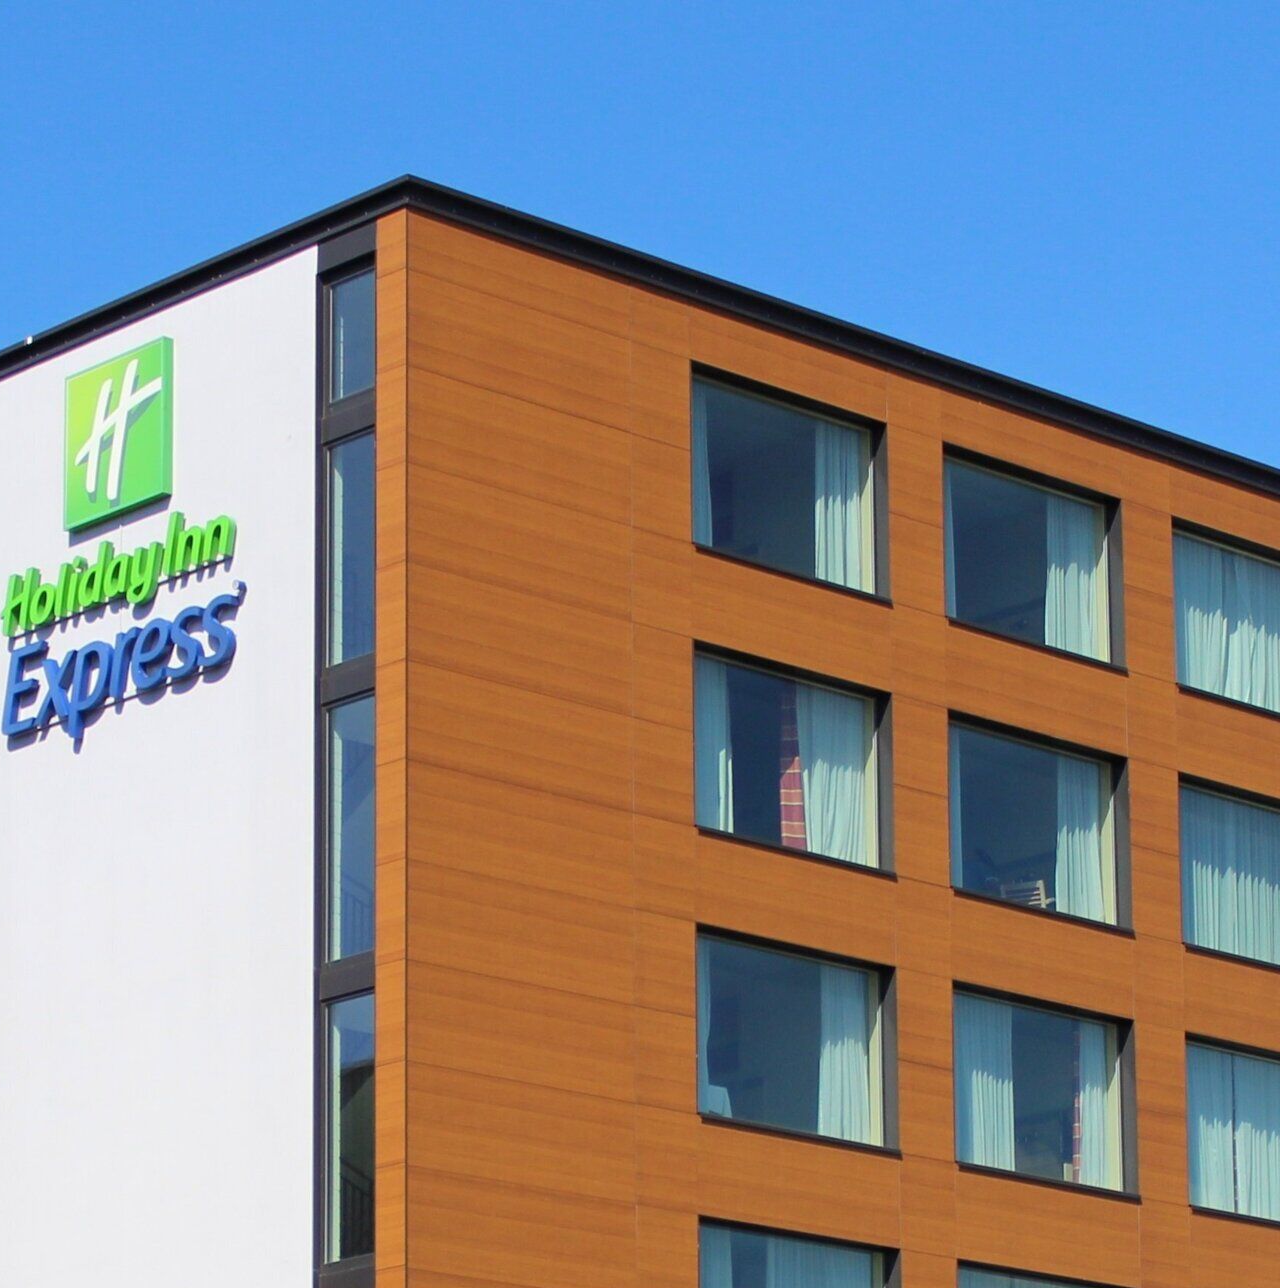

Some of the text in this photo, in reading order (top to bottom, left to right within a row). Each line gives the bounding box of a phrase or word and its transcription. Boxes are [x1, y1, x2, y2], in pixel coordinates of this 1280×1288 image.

[1, 511, 237, 637] Holiday Inn
[1, 580, 246, 738] Express
